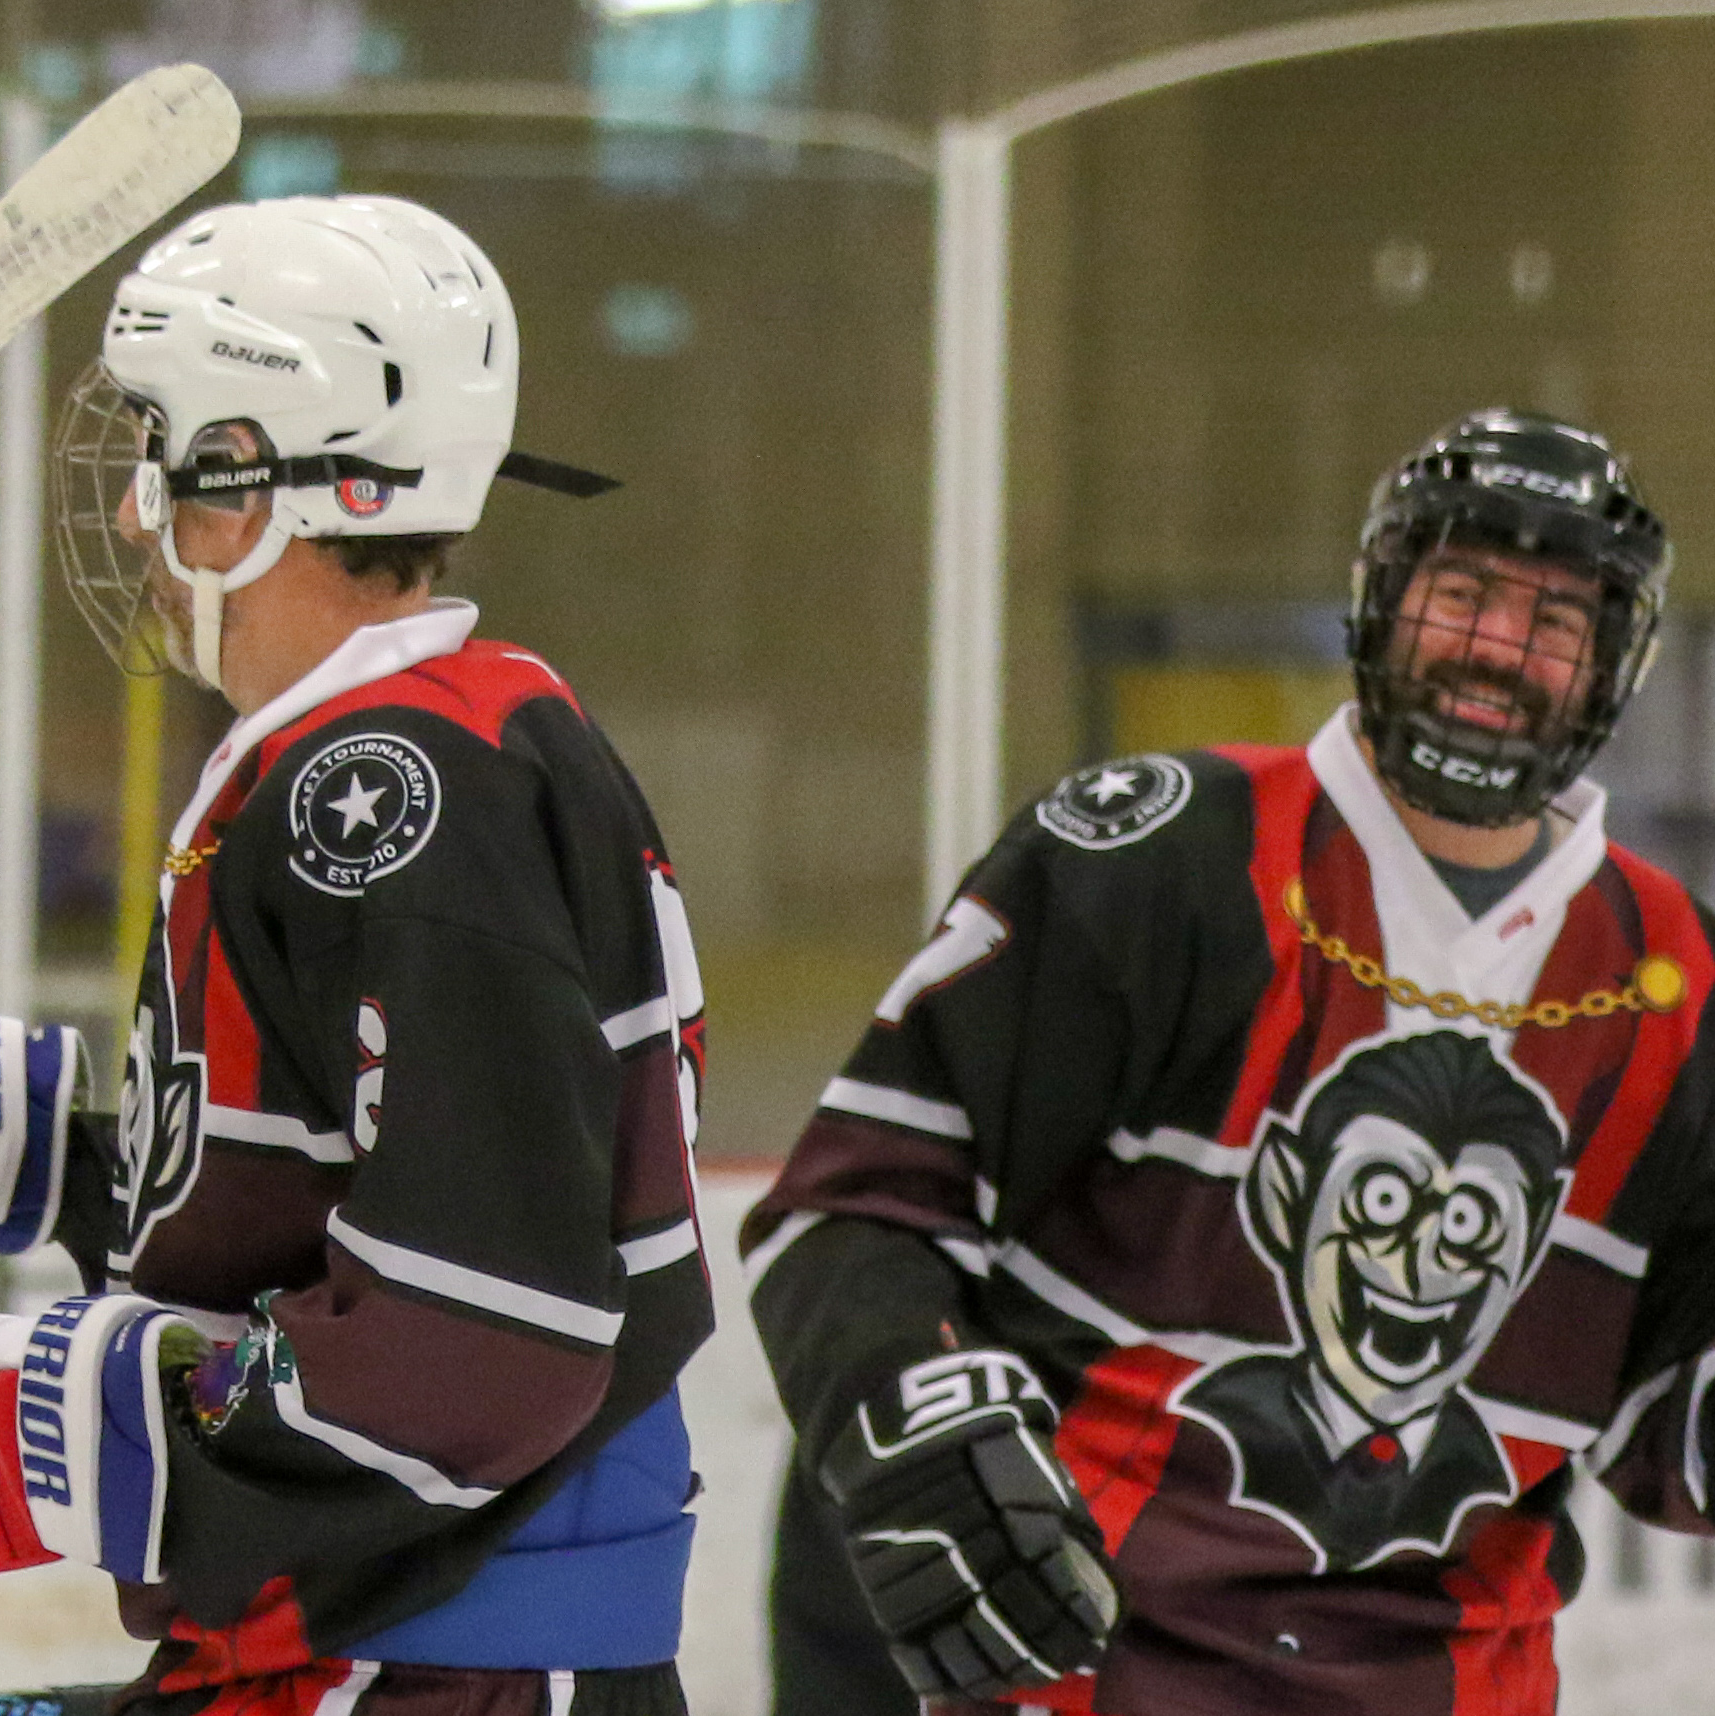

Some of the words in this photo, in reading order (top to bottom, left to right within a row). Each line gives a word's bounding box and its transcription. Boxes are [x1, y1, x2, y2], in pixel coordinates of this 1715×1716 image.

[212, 341, 300, 373] BAUER
[198, 467, 271, 490] BAUER
[322, 741, 427, 811] TOURNAMENT
[17, 1300, 92, 1507] RRIOR
